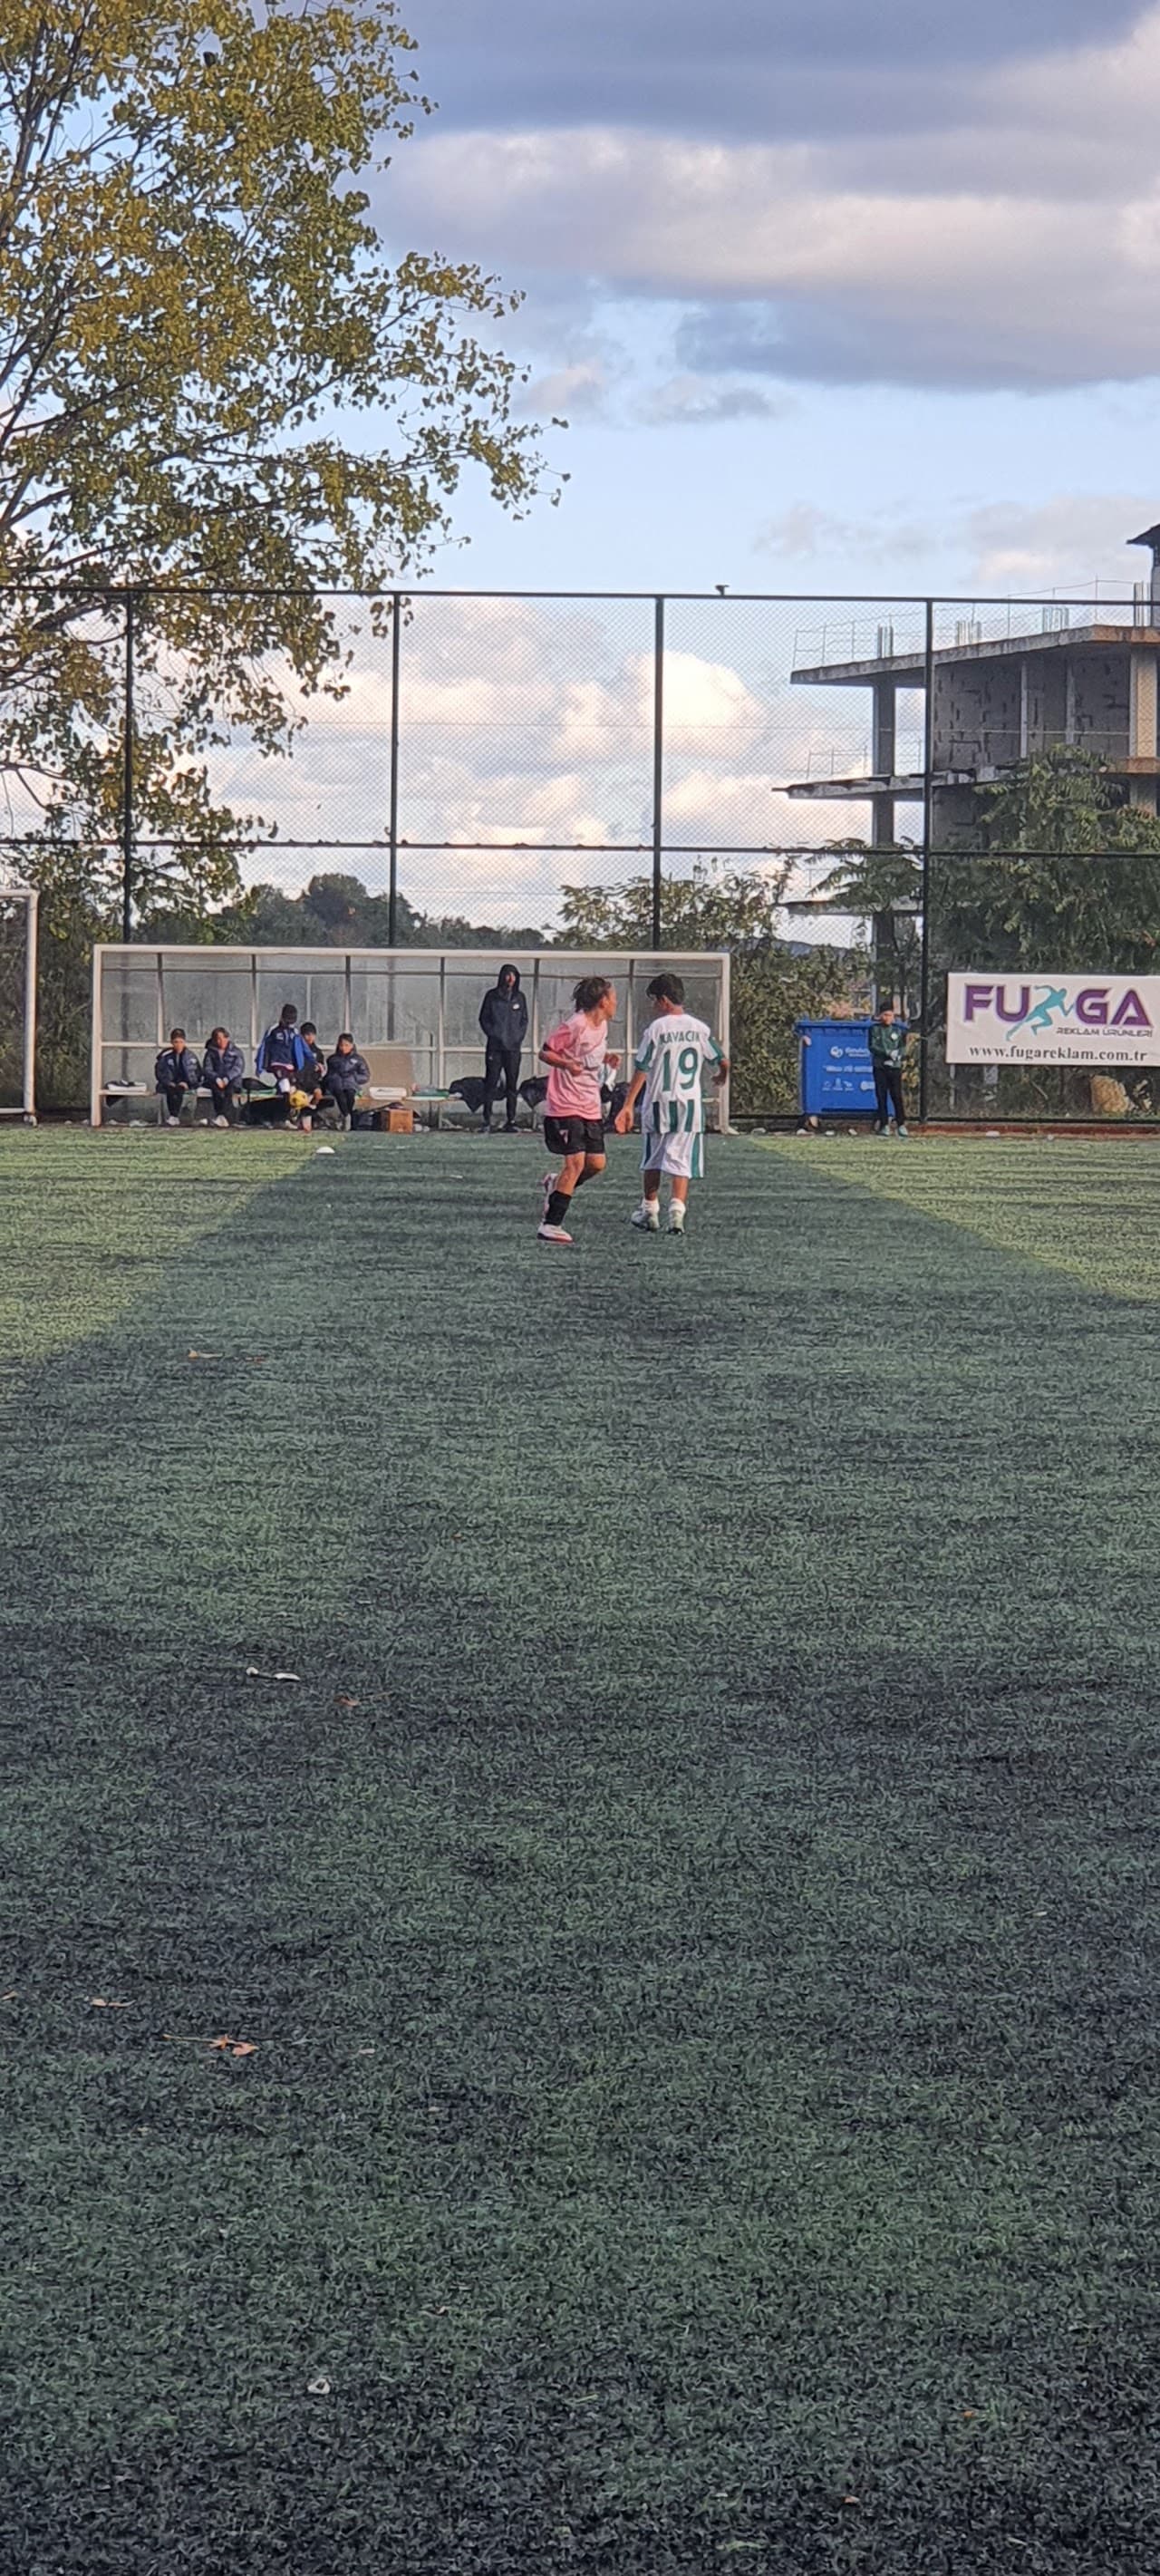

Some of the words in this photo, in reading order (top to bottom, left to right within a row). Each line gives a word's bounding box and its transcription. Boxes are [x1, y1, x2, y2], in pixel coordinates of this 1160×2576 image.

[964, 984, 1152, 1026] FUGA
[1056, 1027, 1099, 1035] REKLAM
[970, 1046, 1147, 1061] www.fugareklam.com.tr
[662, 1048, 698, 1091] 19
